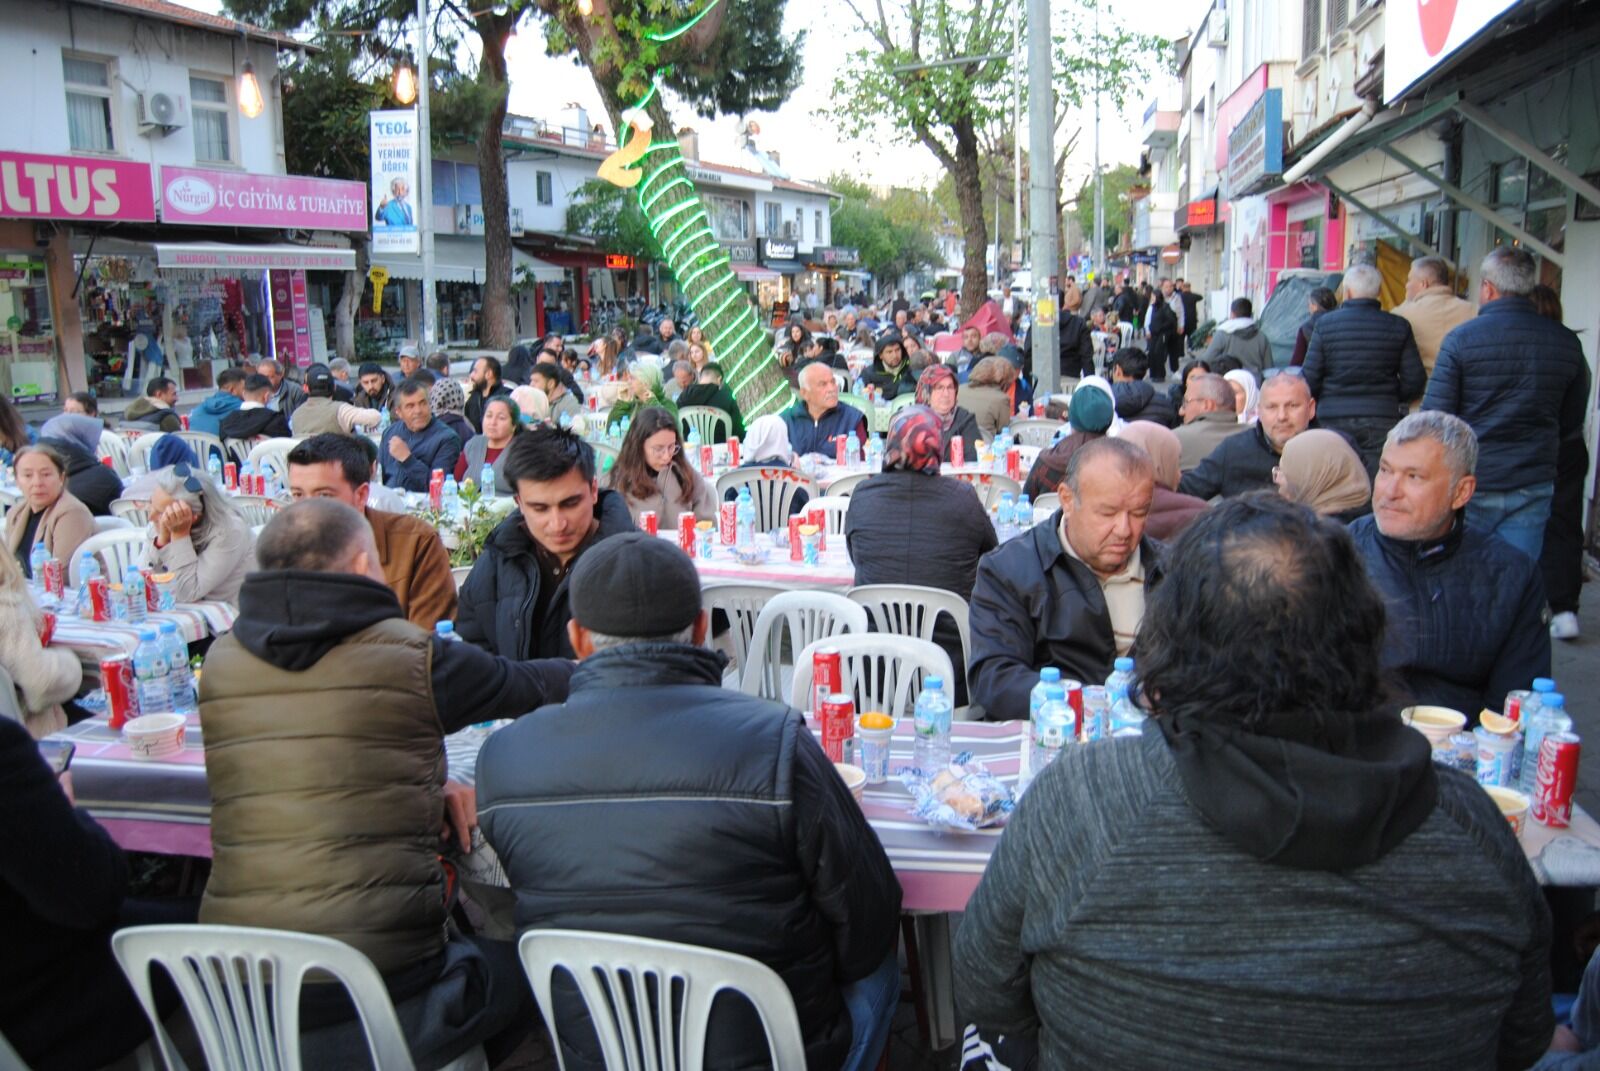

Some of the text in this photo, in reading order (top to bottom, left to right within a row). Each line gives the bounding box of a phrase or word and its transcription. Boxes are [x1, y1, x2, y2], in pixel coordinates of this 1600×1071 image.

[375, 121, 412, 135] TEOL
[378, 147, 411, 159] YERİNDE
[381, 161, 409, 173] ÖĞREN
[0, 160, 120, 216] LTUS
[218, 185, 364, 216] İÇ GİYİM & TUHAFİYE
